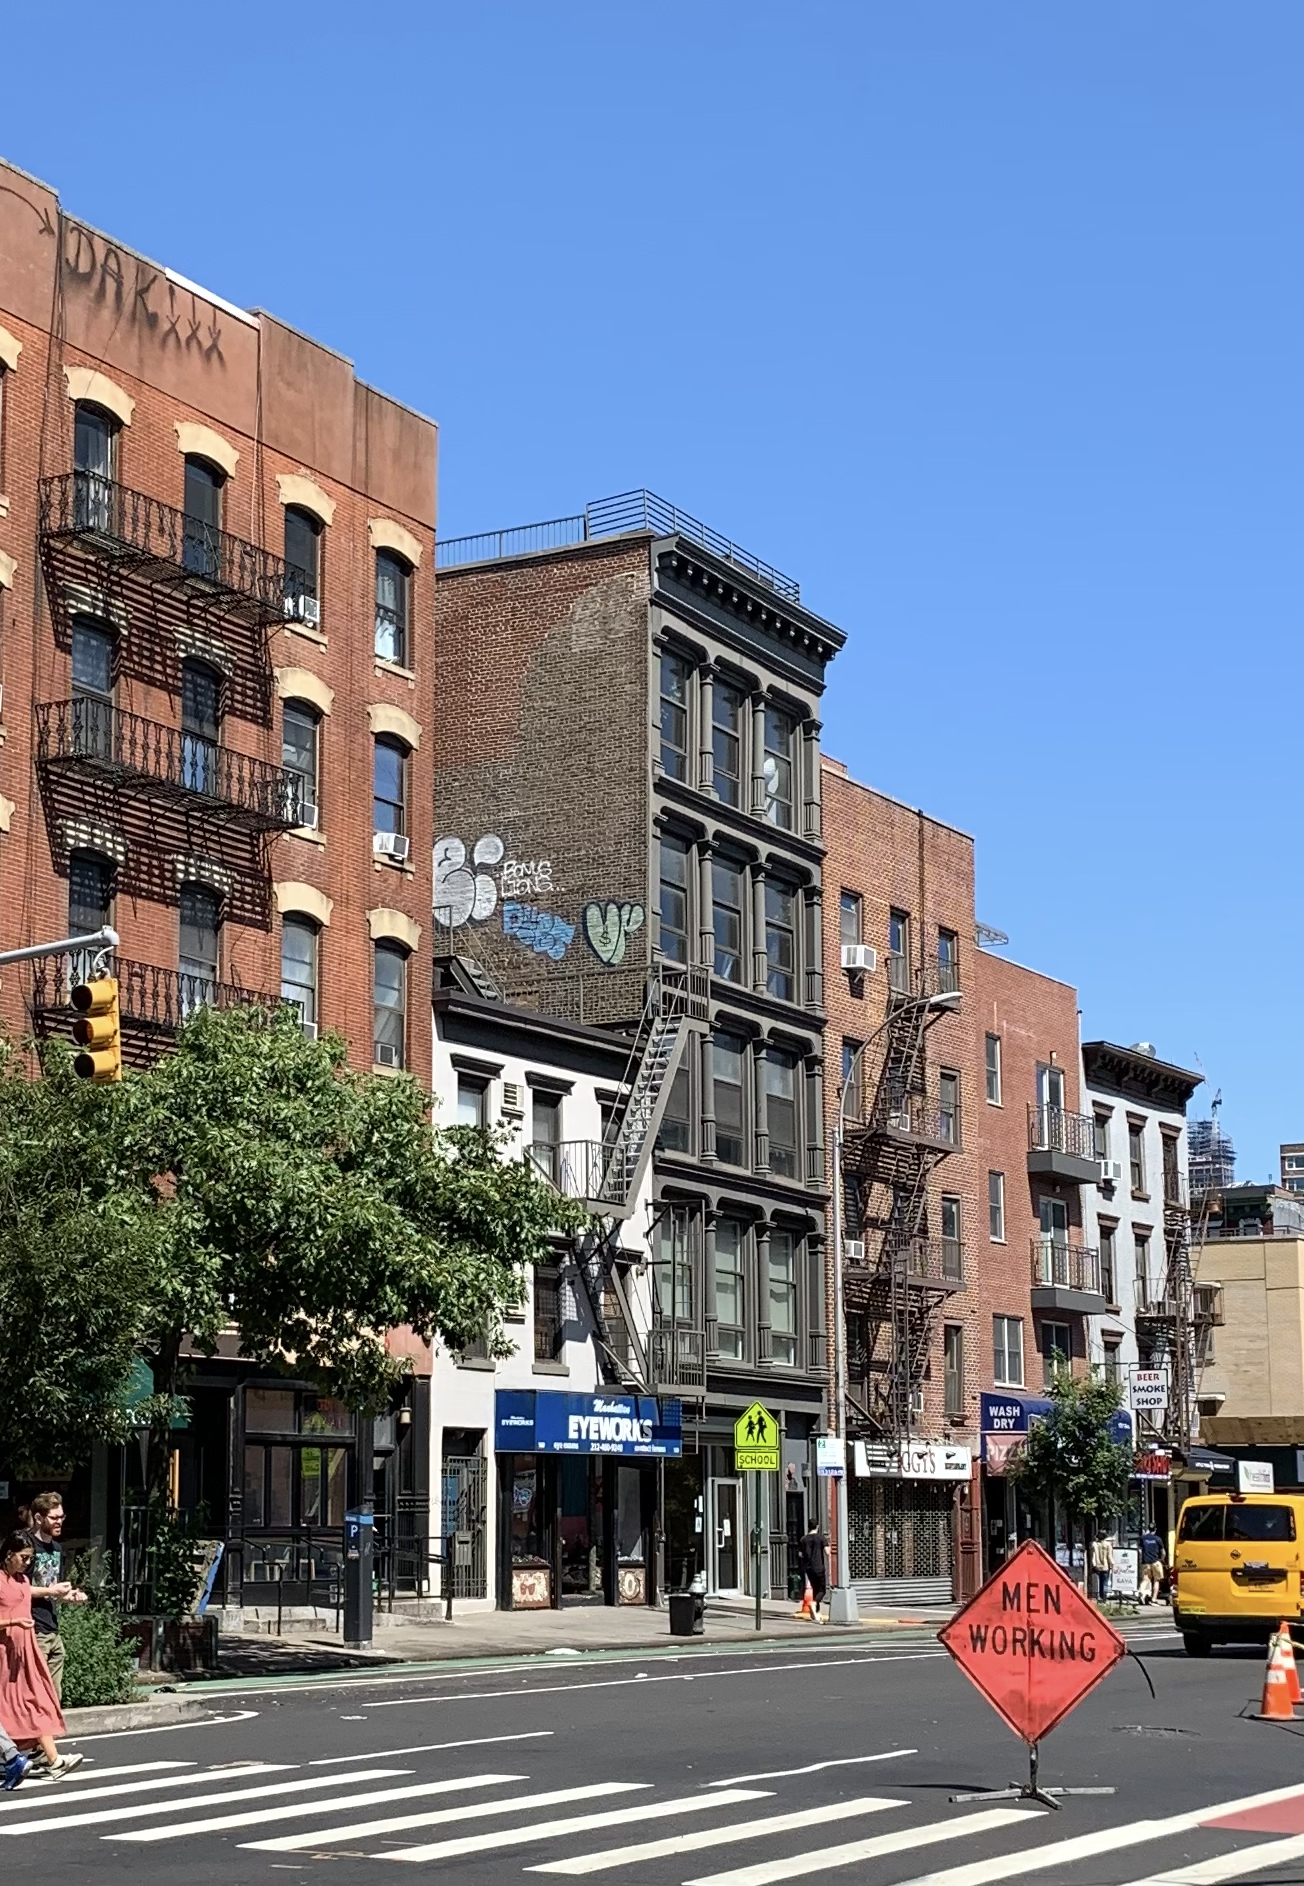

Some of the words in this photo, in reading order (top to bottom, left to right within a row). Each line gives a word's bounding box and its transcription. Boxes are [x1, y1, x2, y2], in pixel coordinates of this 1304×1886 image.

[1136, 1373, 1160, 1381] BEER
[1132, 1385, 1166, 1393] SMOKE
[1136, 1397, 1163, 1406] SHOP
[989, 1405, 1020, 1417] WASH
[568, 1415, 653, 1442] EYEWORKS
[993, 1418, 1015, 1429] DRY
[986, 1444, 1025, 1462] PIZZ
[739, 1455, 775, 1466] SCHOOL
[350, 1524, 359, 1537] P
[1001, 1580, 1062, 1615] MEN
[968, 1624, 1096, 1663] WORKING
